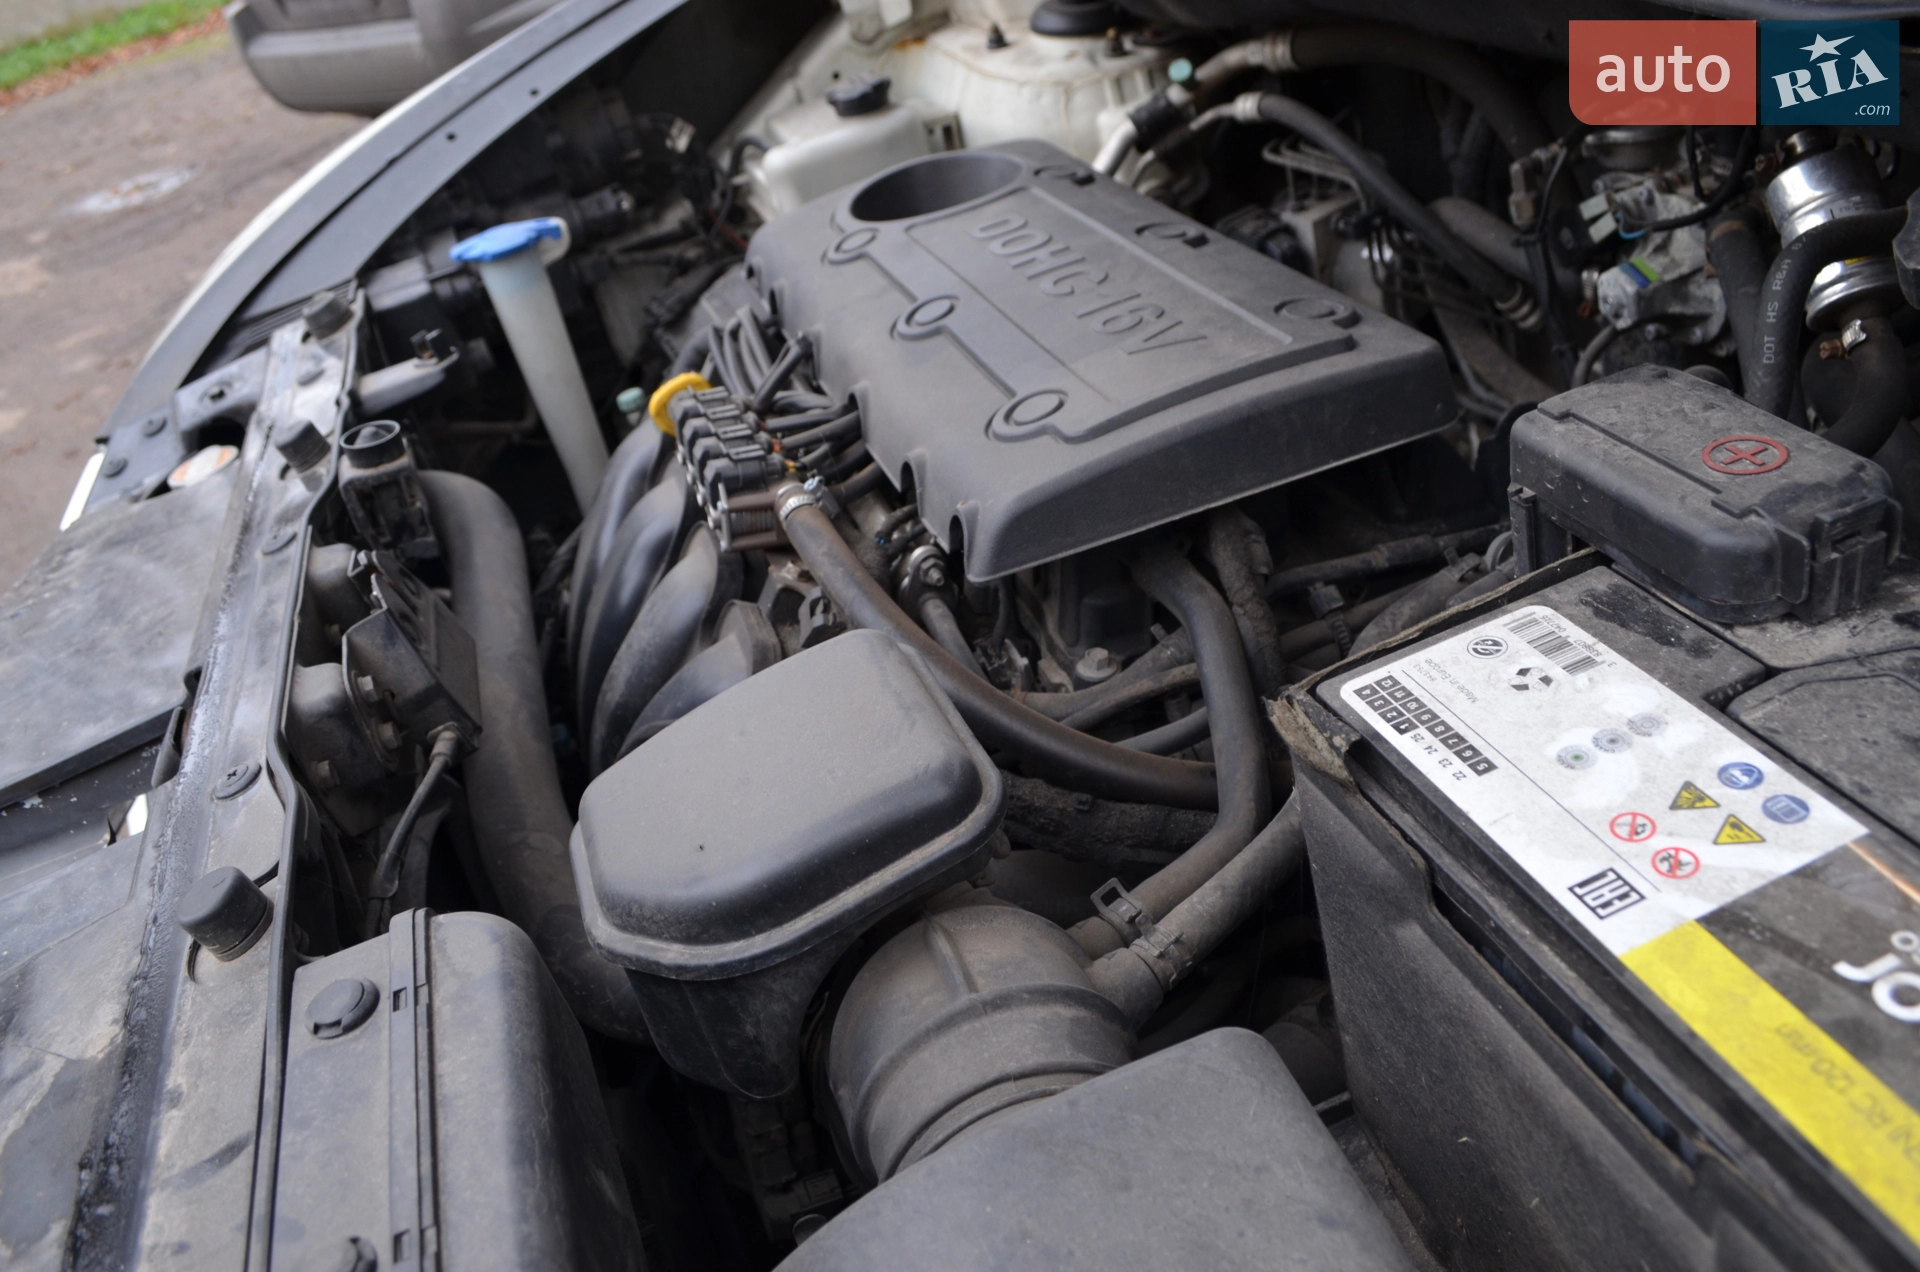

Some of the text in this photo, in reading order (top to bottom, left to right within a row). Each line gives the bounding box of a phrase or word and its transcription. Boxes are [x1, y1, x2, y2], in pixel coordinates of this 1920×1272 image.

[1766, 301, 1779, 323] HS
[1763, 334, 1775, 364] DOT
[1424, 658, 1452, 680] Europe
[1381, 678, 1393, 688] 12
[1393, 689, 1406, 699] 11
[1456, 684, 1479, 703] Made
[1406, 701, 1419, 711] 10
[1410, 732, 1425, 743] 25
[1424, 743, 1439, 755] 24
[1438, 757, 1454, 769] 23
[1452, 769, 1468, 782] 22
